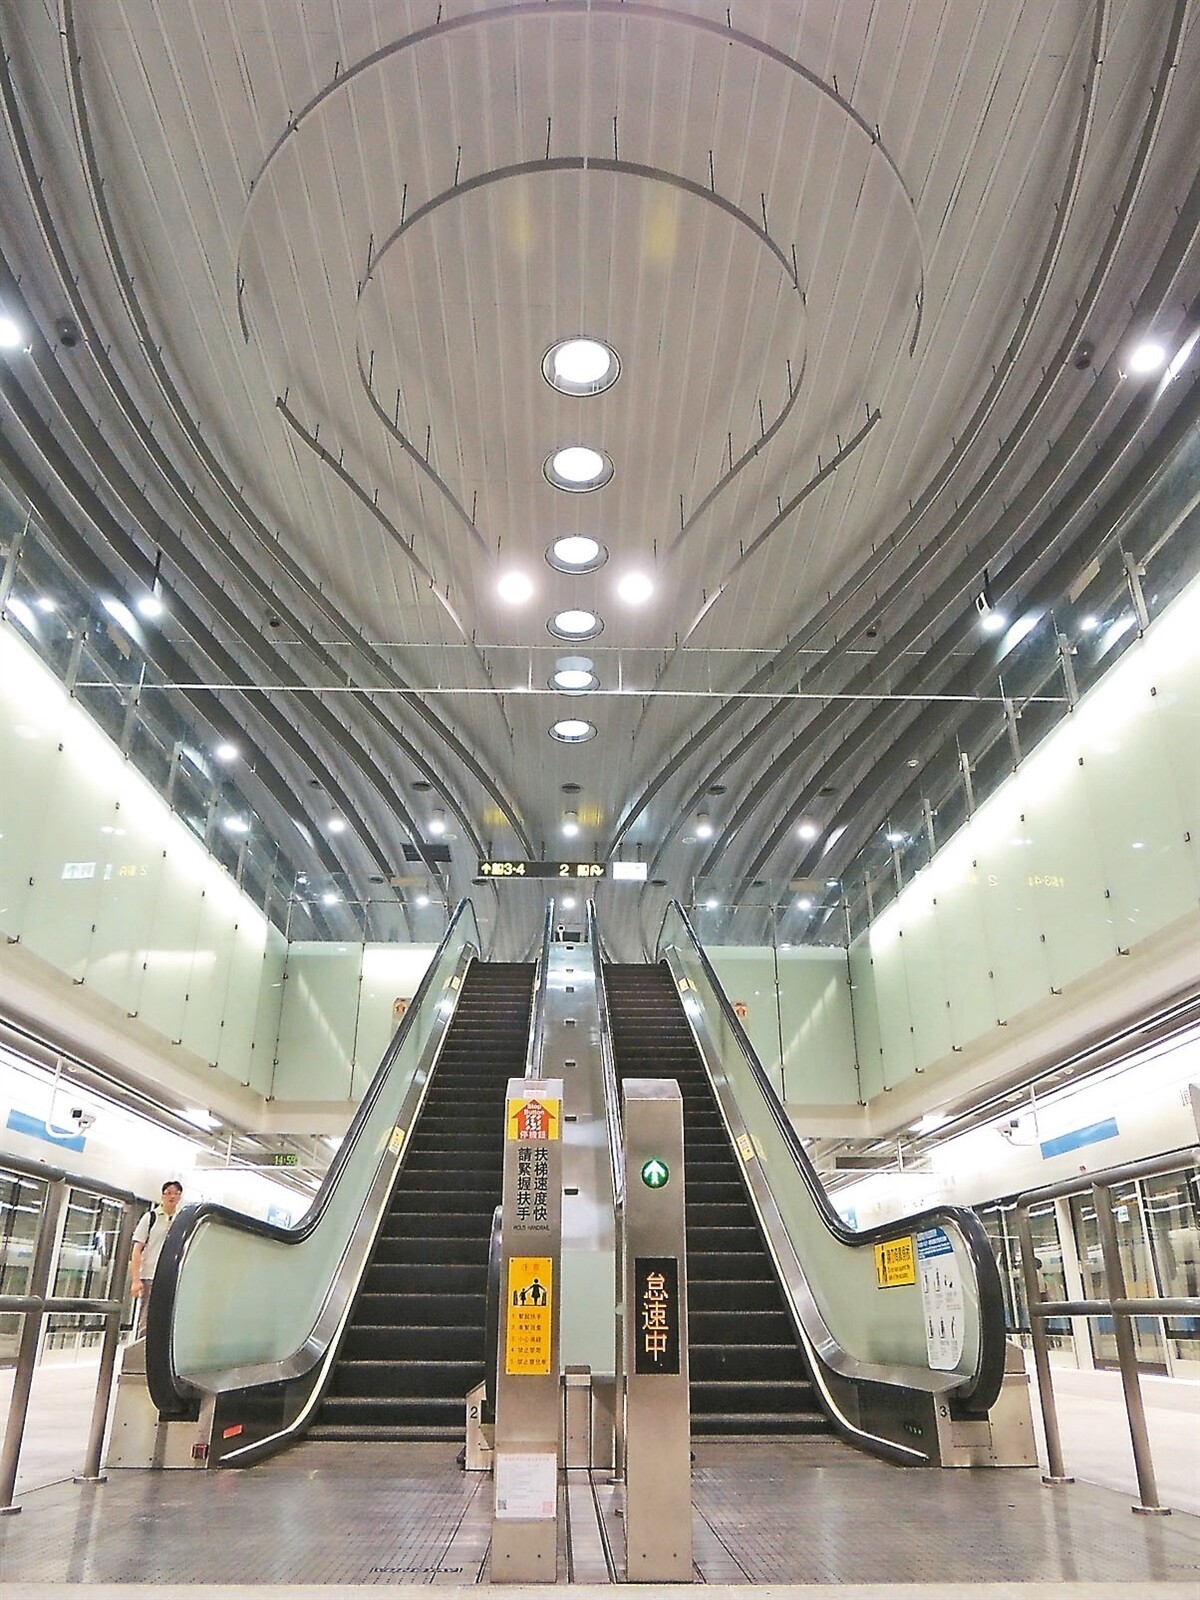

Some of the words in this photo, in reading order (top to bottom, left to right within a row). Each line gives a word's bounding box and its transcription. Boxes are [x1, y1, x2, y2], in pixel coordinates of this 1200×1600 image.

[559, 864, 569, 876] 2
[516, 1147, 531, 1221] 請緊握扶手
[533, 1147, 548, 1221] 扶梯速度快
[642, 1272, 669, 1362] 怠速中
[470, 1406, 477, 1419] 2
[939, 1405, 948, 1418] 3
